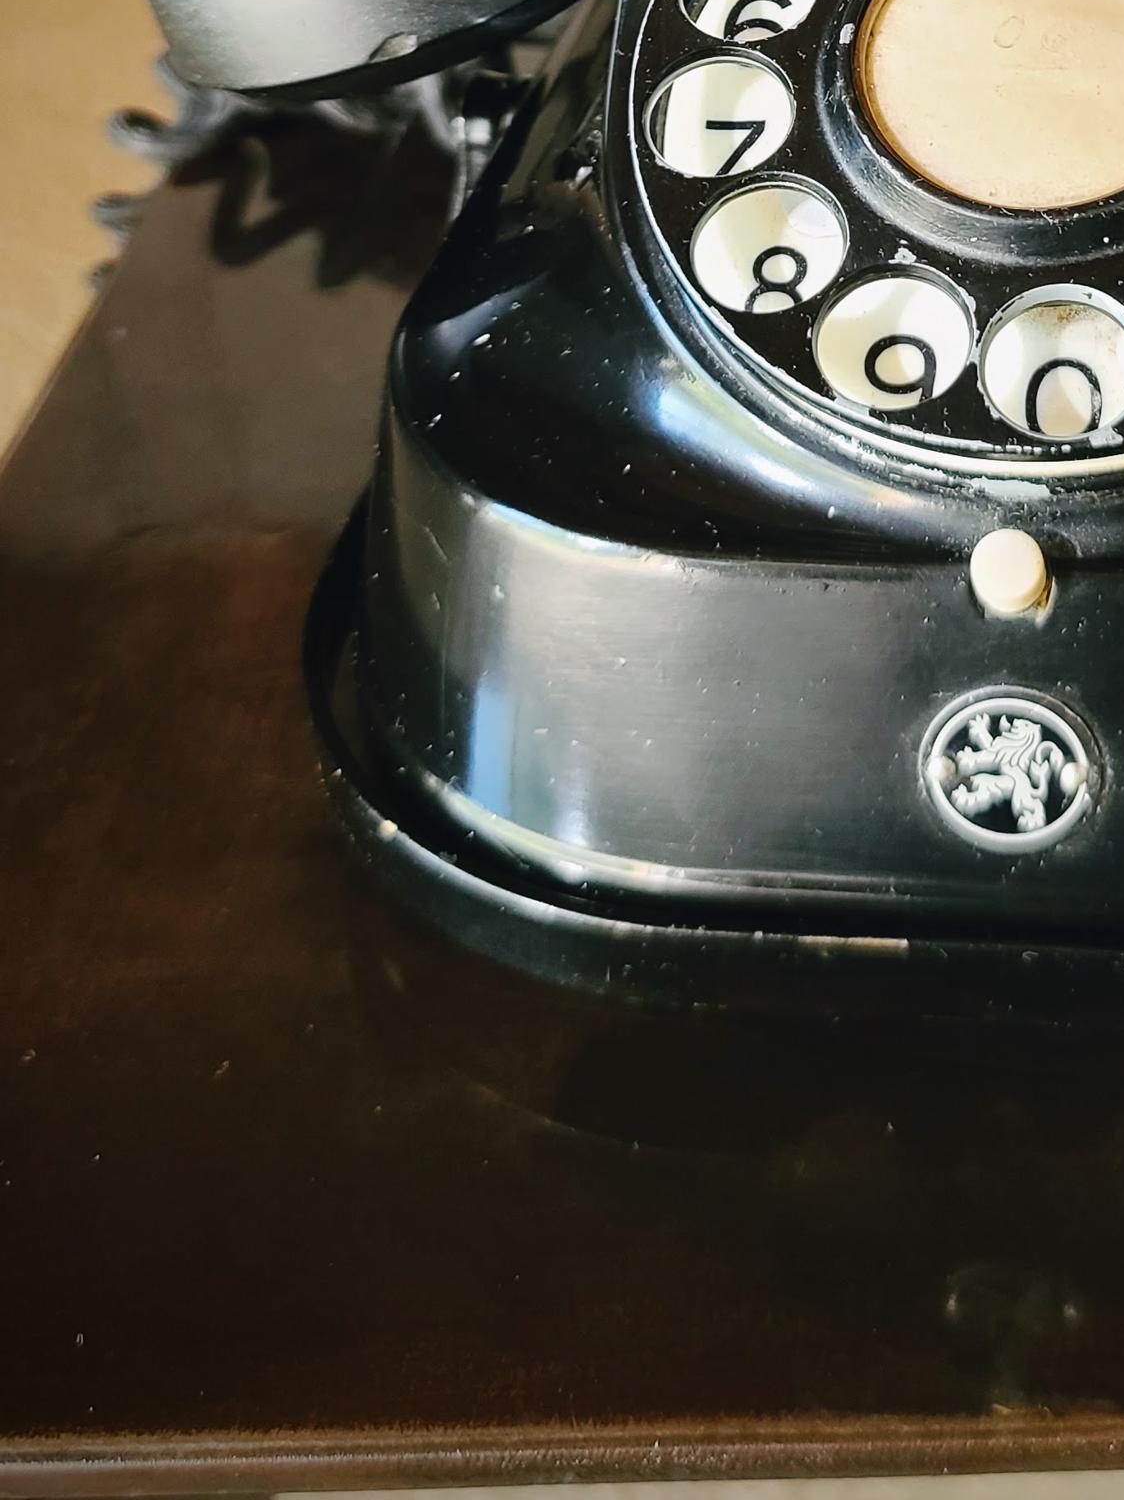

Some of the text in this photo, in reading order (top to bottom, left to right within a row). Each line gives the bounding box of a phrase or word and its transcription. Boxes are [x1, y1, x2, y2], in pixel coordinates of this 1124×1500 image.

[706, 118, 766, 175] 7
[746, 246, 807, 312] 8
[864, 335, 936, 401] 9
[1024, 357, 1102, 433] 0
